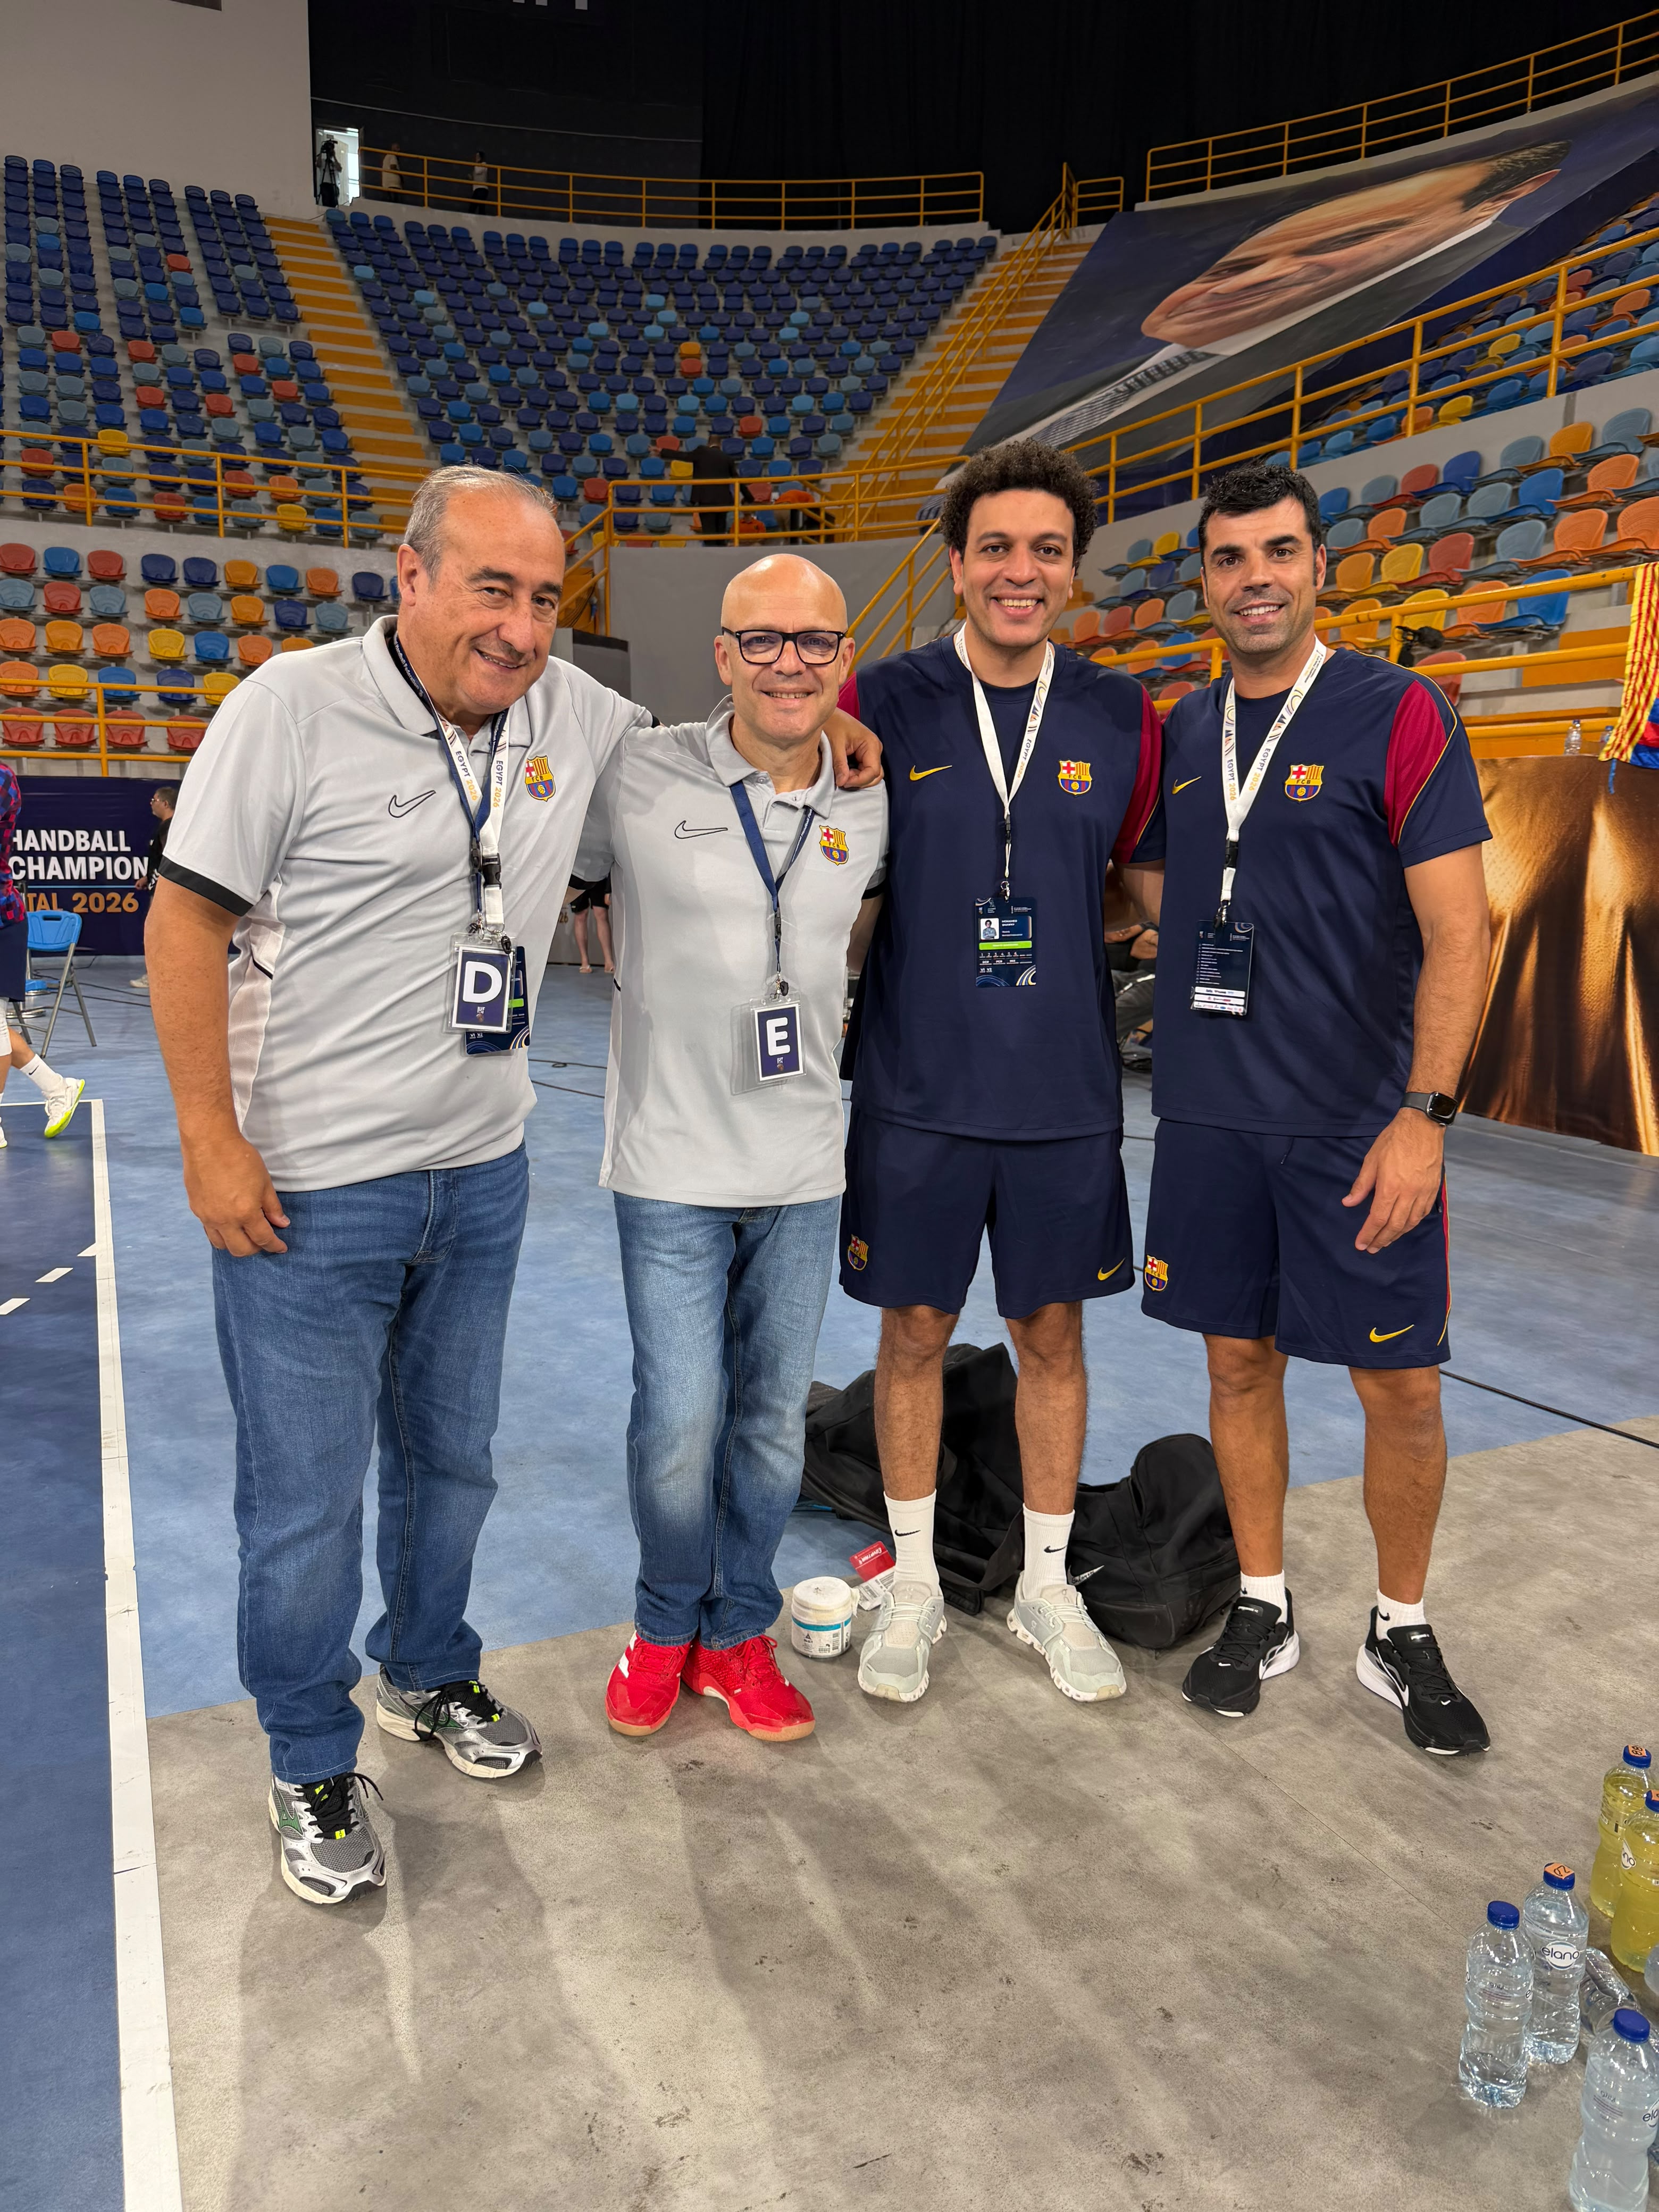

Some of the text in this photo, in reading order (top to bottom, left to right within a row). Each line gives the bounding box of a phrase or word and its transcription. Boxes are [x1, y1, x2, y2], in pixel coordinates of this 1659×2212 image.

[1023, 739, 1032, 760] EGYPT
[456, 751, 478, 801] EGYPT 2026
[1249, 748, 1271, 791] EGYPT 2026
[493, 787, 501, 808] 2026
[13, 830, 131, 852] HANDBALL
[72, 892, 139, 914] 2026
[463, 961, 502, 1003] D
[766, 1017, 791, 1056] E
[1542, 1947, 1579, 1960] elano
